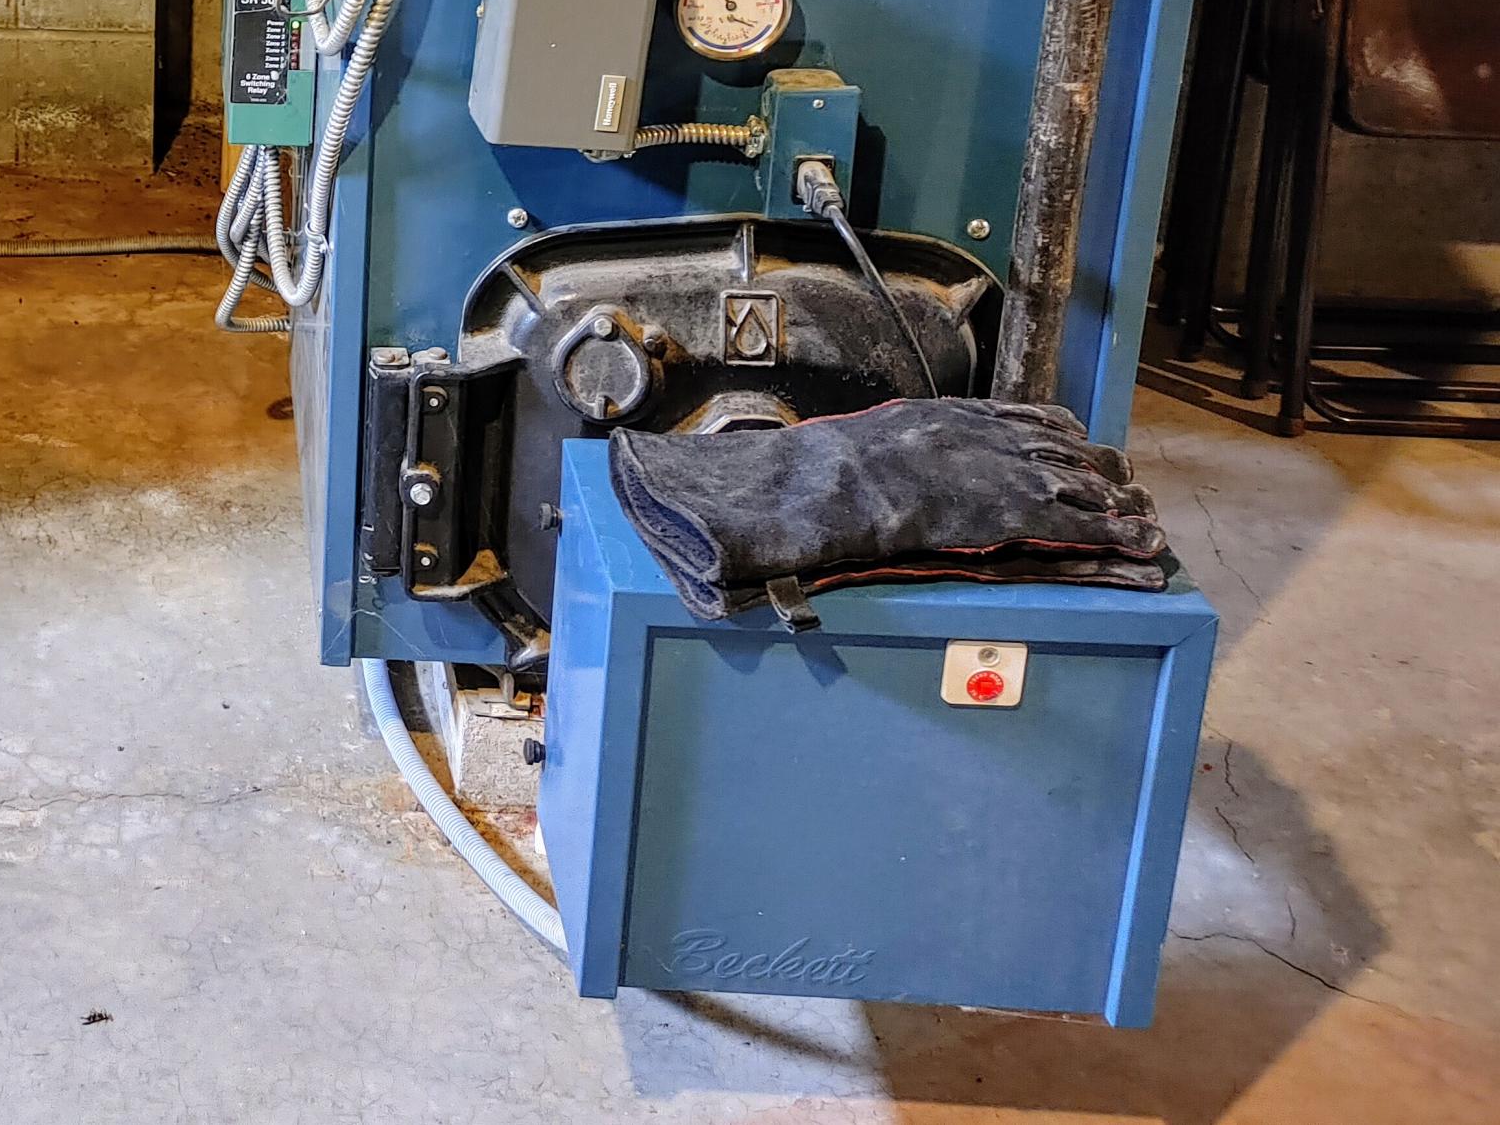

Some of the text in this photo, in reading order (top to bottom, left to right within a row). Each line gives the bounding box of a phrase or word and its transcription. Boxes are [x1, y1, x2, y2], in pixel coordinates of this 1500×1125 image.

[240, 80, 275, 88] Switching
[248, 87, 268, 95] Relay
[602, 83, 617, 125] Honeywell
[658, 928, 877, 985] Beckett
